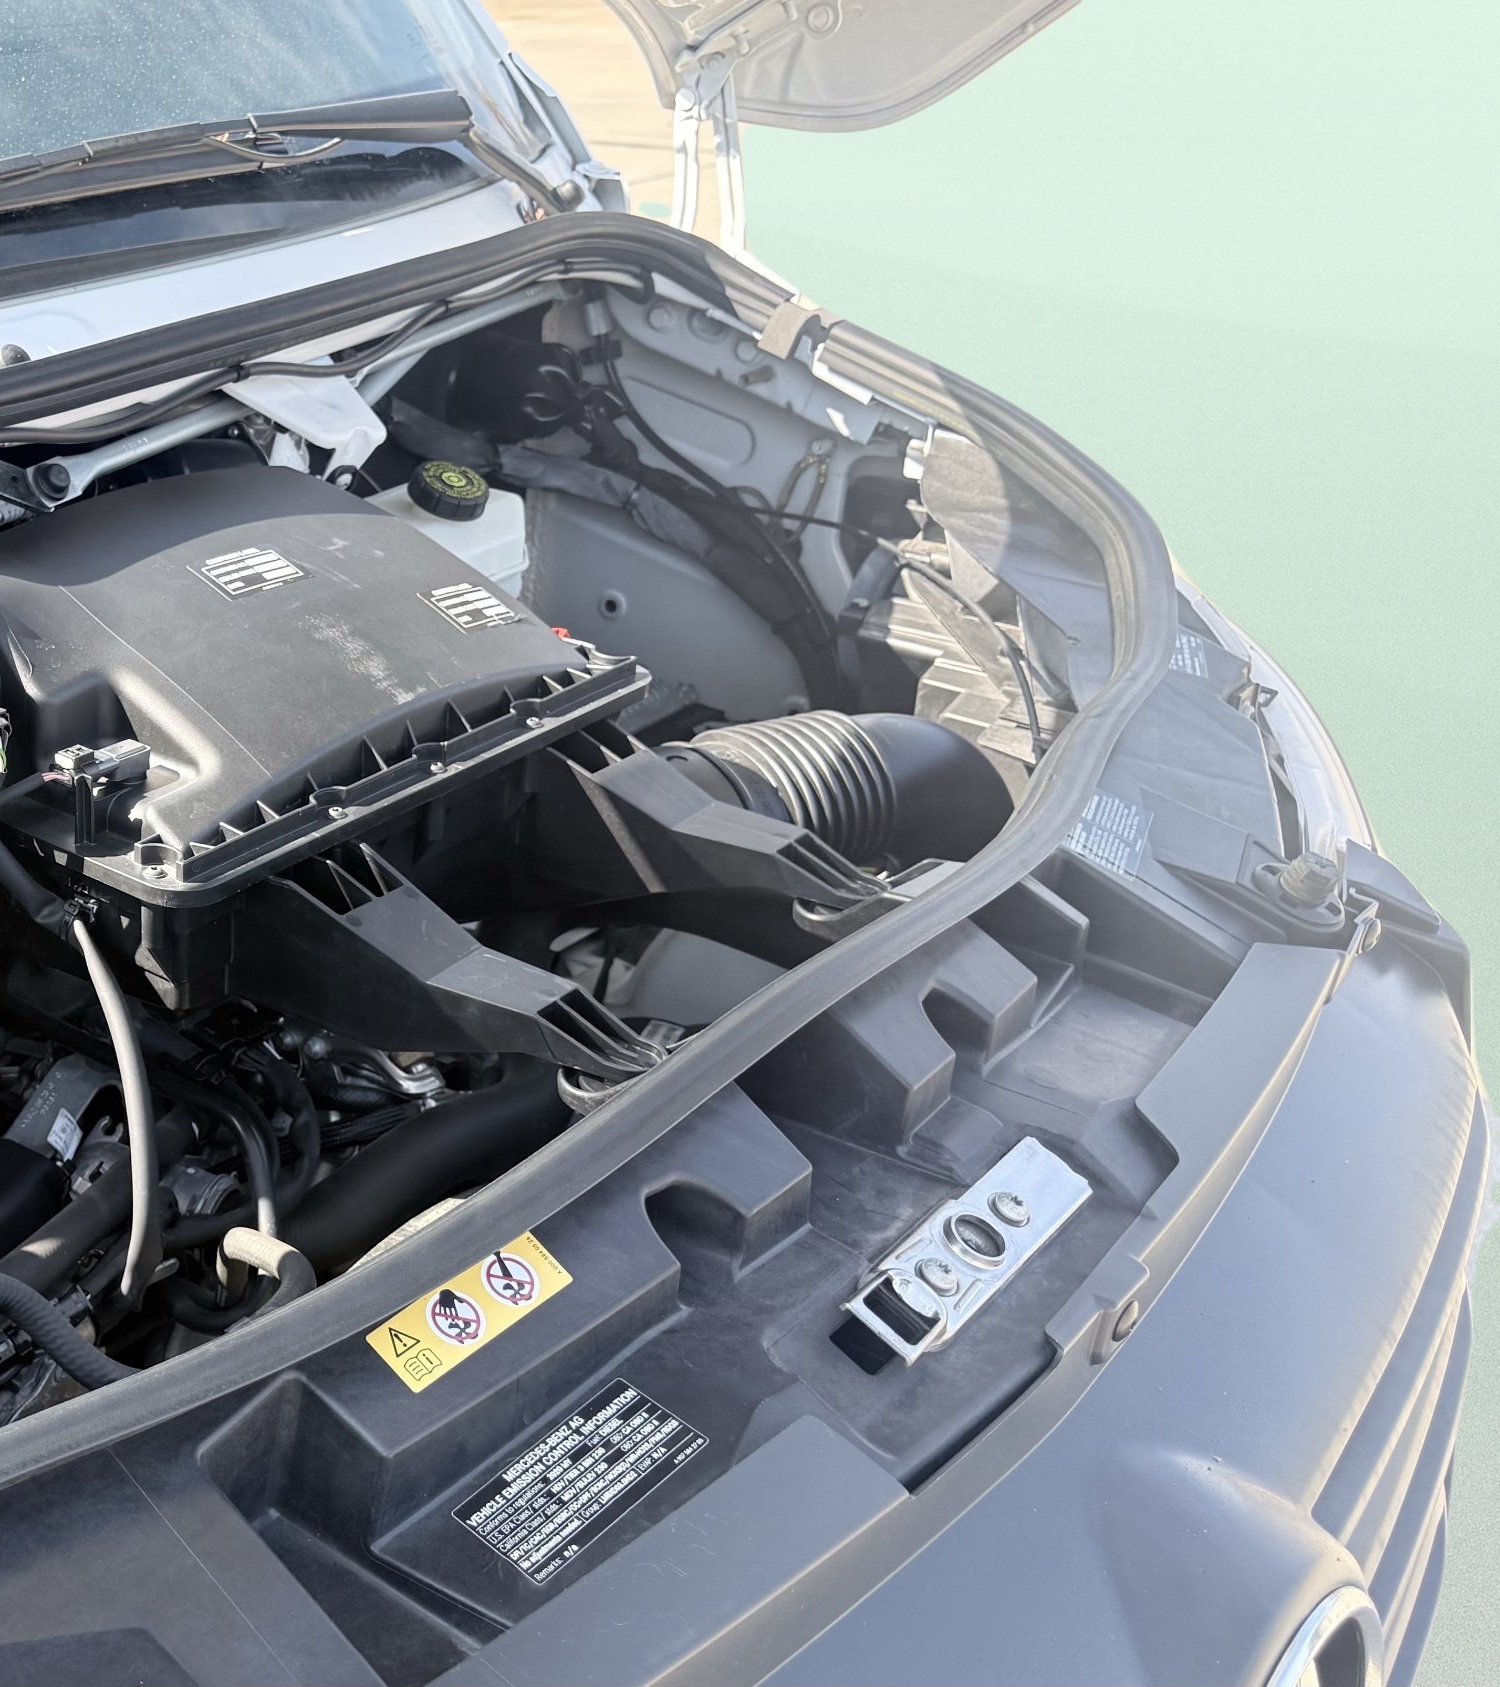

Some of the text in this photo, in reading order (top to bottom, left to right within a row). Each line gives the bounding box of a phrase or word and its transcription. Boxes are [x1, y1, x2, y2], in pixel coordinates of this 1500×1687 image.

[466, 1388, 637, 1527] VEHICLE EMISSION CONTROL INFORMATION
[502, 1416, 584, 1482] MERCEDES-BENZ AG
[651, 1447, 667, 1459] N/A
[477, 1509, 508, 1536] Conforms
[510, 1478, 546, 1509] regulations:
[546, 1466, 564, 1480] 2020
[586, 1434, 603, 1447] Fuel:
[598, 1418, 623, 1437] DIESEL
[498, 1526, 529, 1552] California
[500, 1521, 517, 1534] EPA
[534, 1557, 564, 1581] Remarks:
